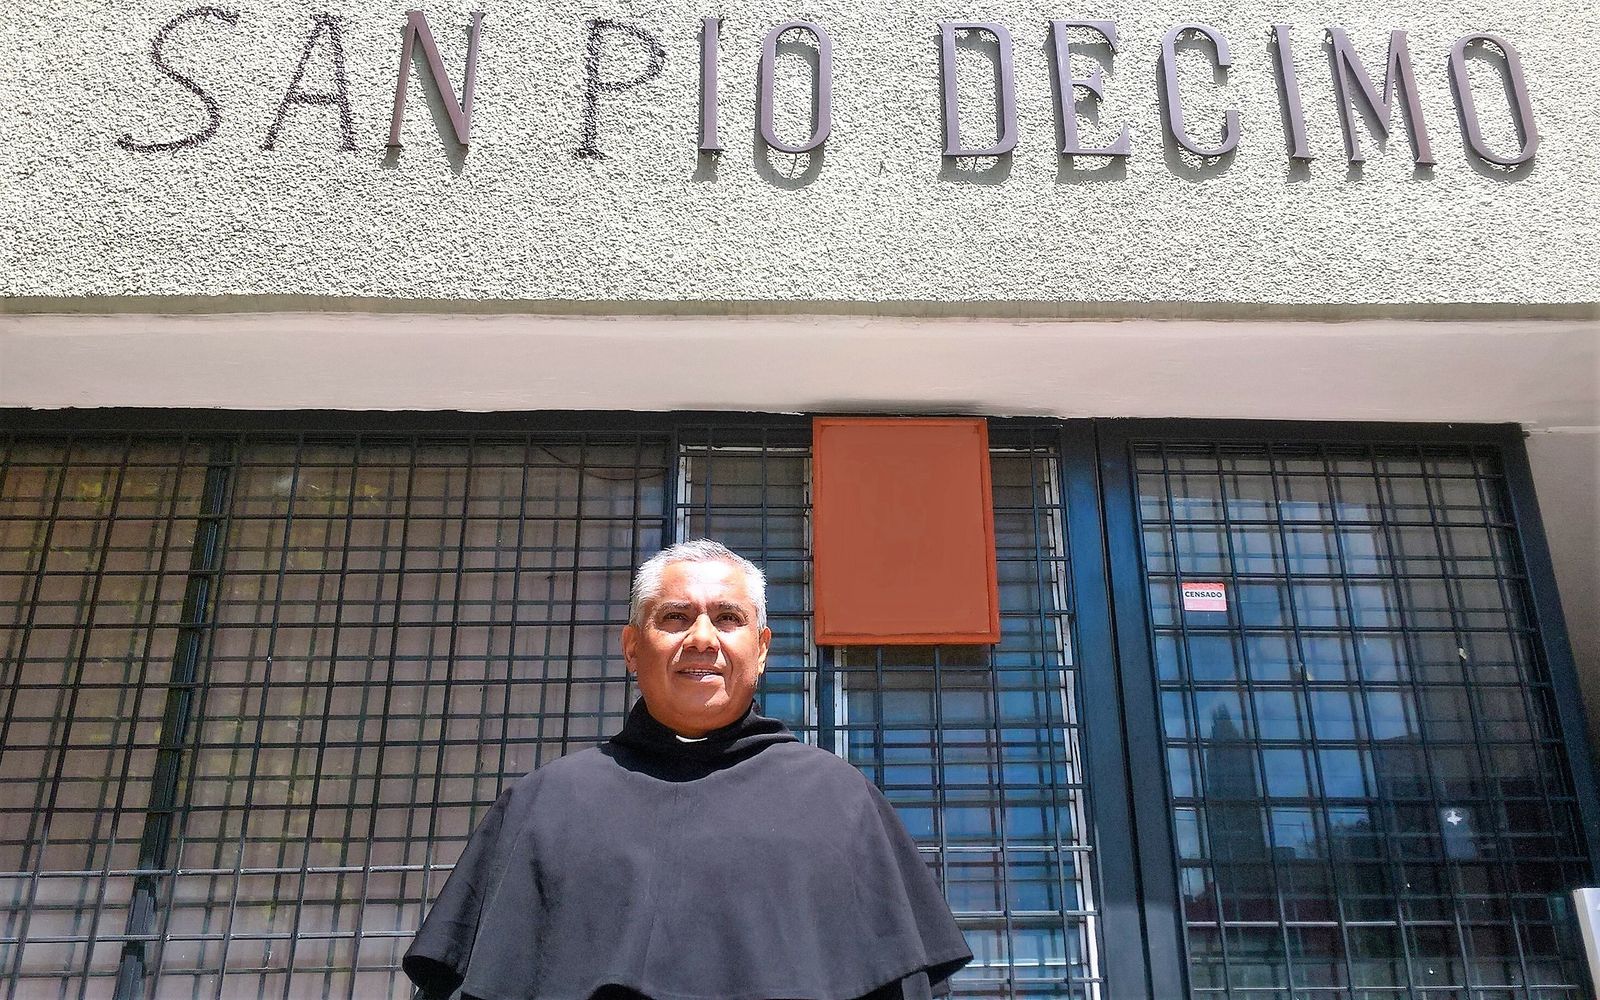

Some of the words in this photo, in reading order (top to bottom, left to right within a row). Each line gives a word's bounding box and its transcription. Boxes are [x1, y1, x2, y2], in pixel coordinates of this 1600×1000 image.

[114, 6, 486, 152] SAN
[573, 17, 833, 158] PIO
[936, 19, 1540, 167] DECIMO
